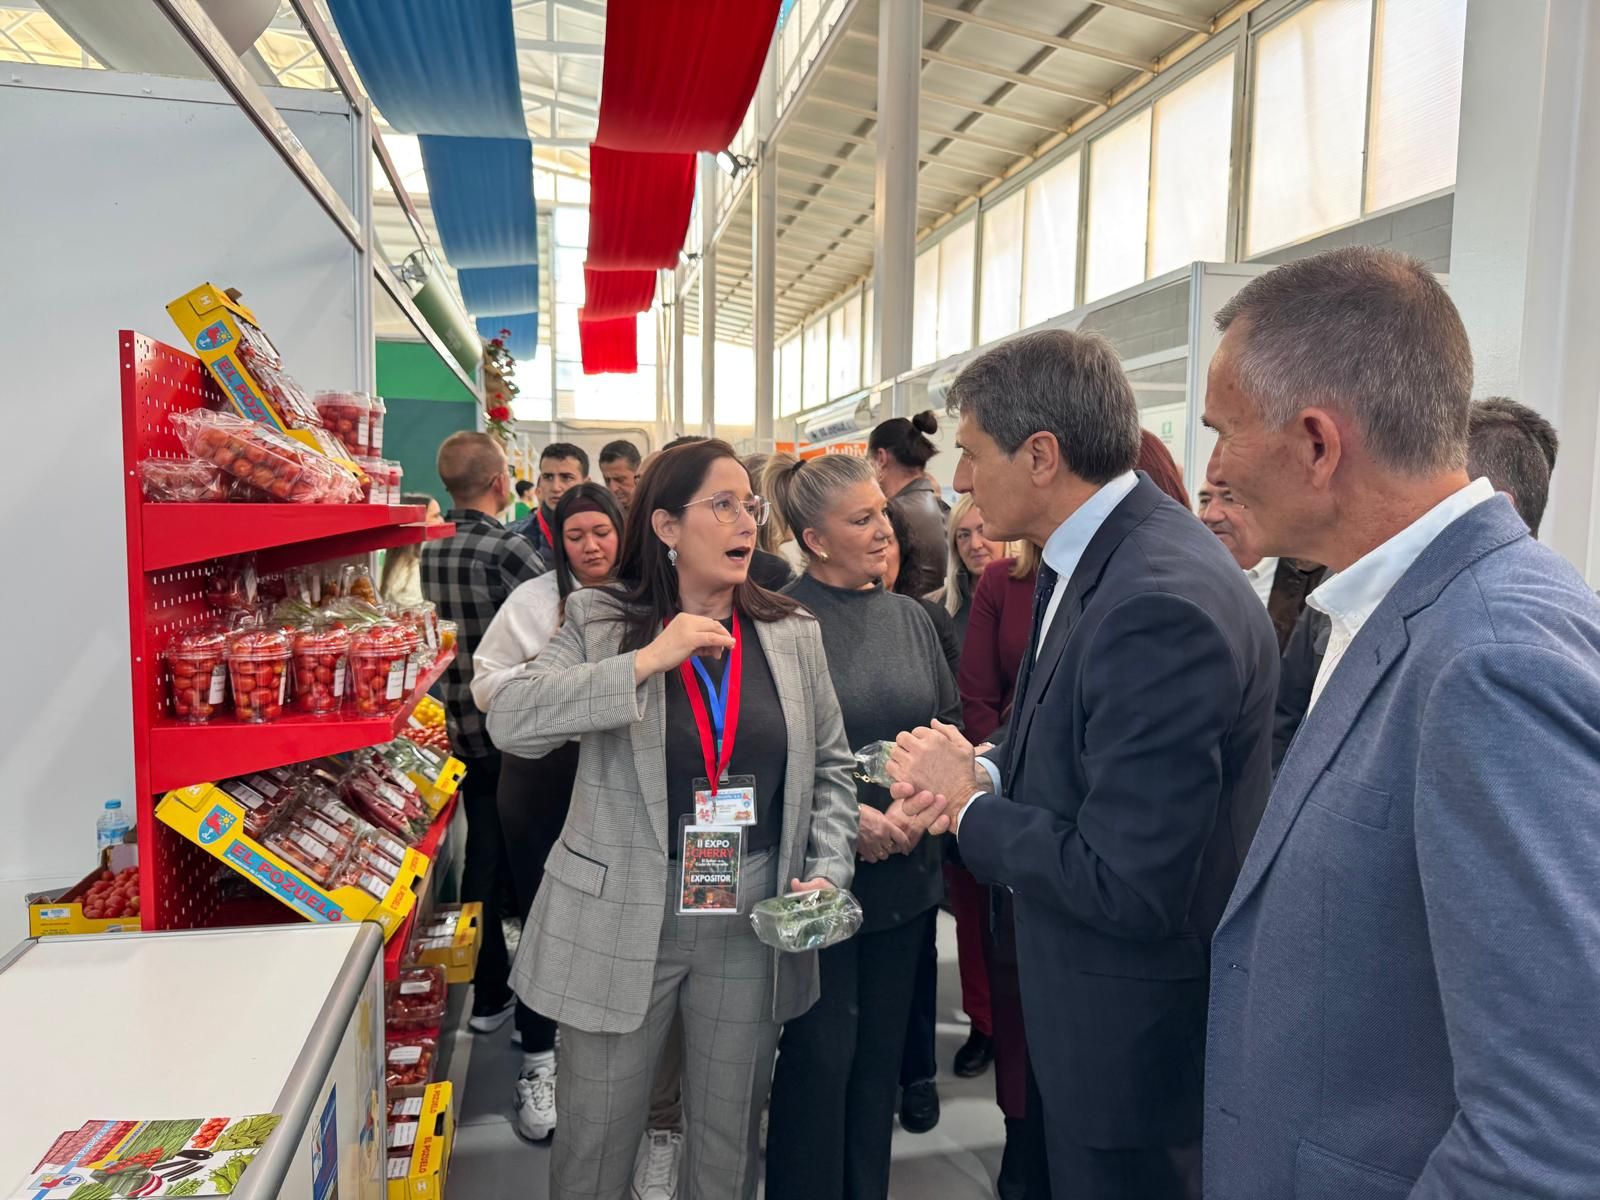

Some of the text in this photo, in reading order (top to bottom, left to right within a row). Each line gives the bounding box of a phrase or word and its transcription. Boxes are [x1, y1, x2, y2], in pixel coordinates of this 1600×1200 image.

[218, 359, 236, 382] EL
[697, 839, 730, 848] II EXPO
[691, 848, 734, 858] CHERRY
[230, 844, 254, 865] EL
[257, 861, 343, 922] POZUELO
[691, 874, 731, 883] EXPOSITOR
